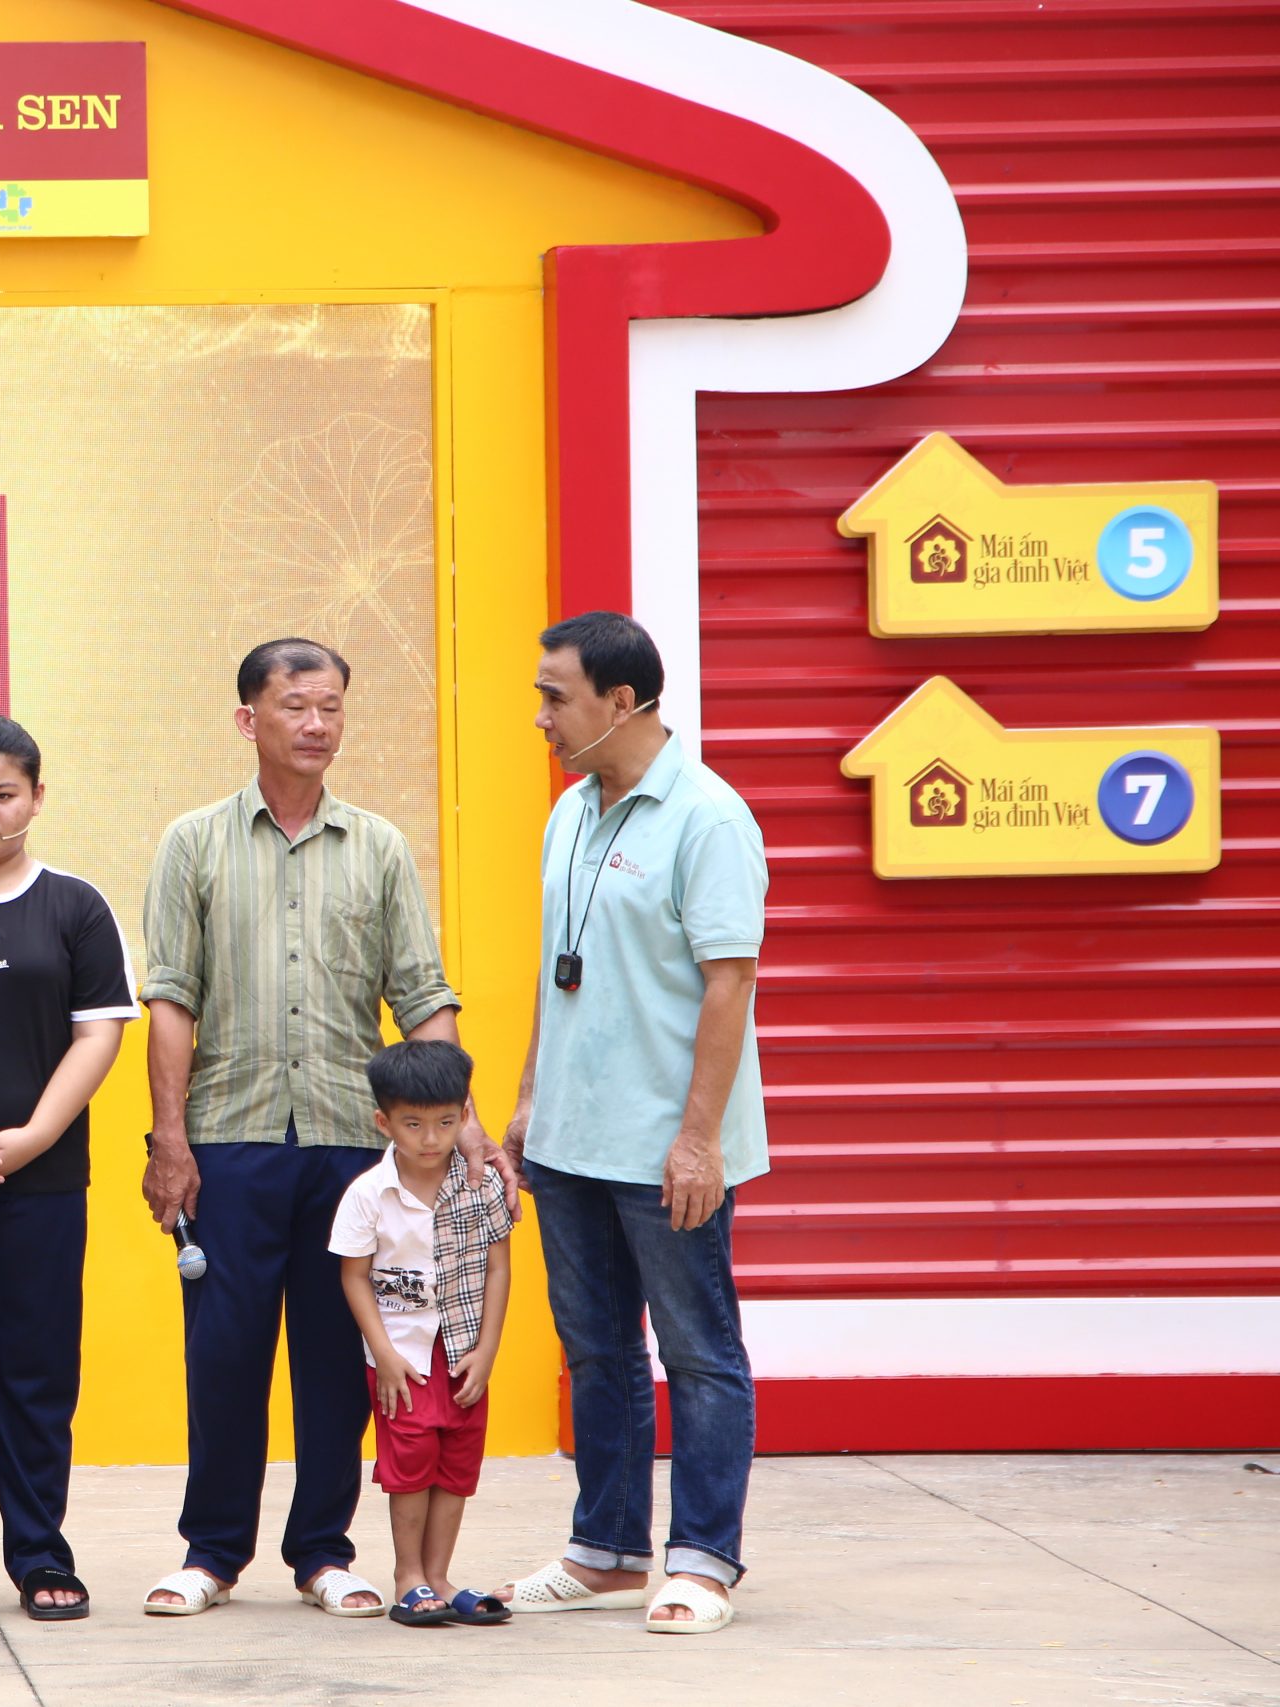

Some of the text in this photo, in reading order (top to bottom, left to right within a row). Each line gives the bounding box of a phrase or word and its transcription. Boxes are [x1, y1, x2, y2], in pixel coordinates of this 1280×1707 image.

[17, 94, 121, 130] SEN
[980, 532, 1048, 558] Mái ấm
[1126, 527, 1168, 579] 5
[973, 557, 1091, 590] gia đình Việt
[980, 776, 1048, 802] Mái ấm
[1125, 774, 1168, 825] 7
[973, 802, 1091, 834] gia đình Việt
